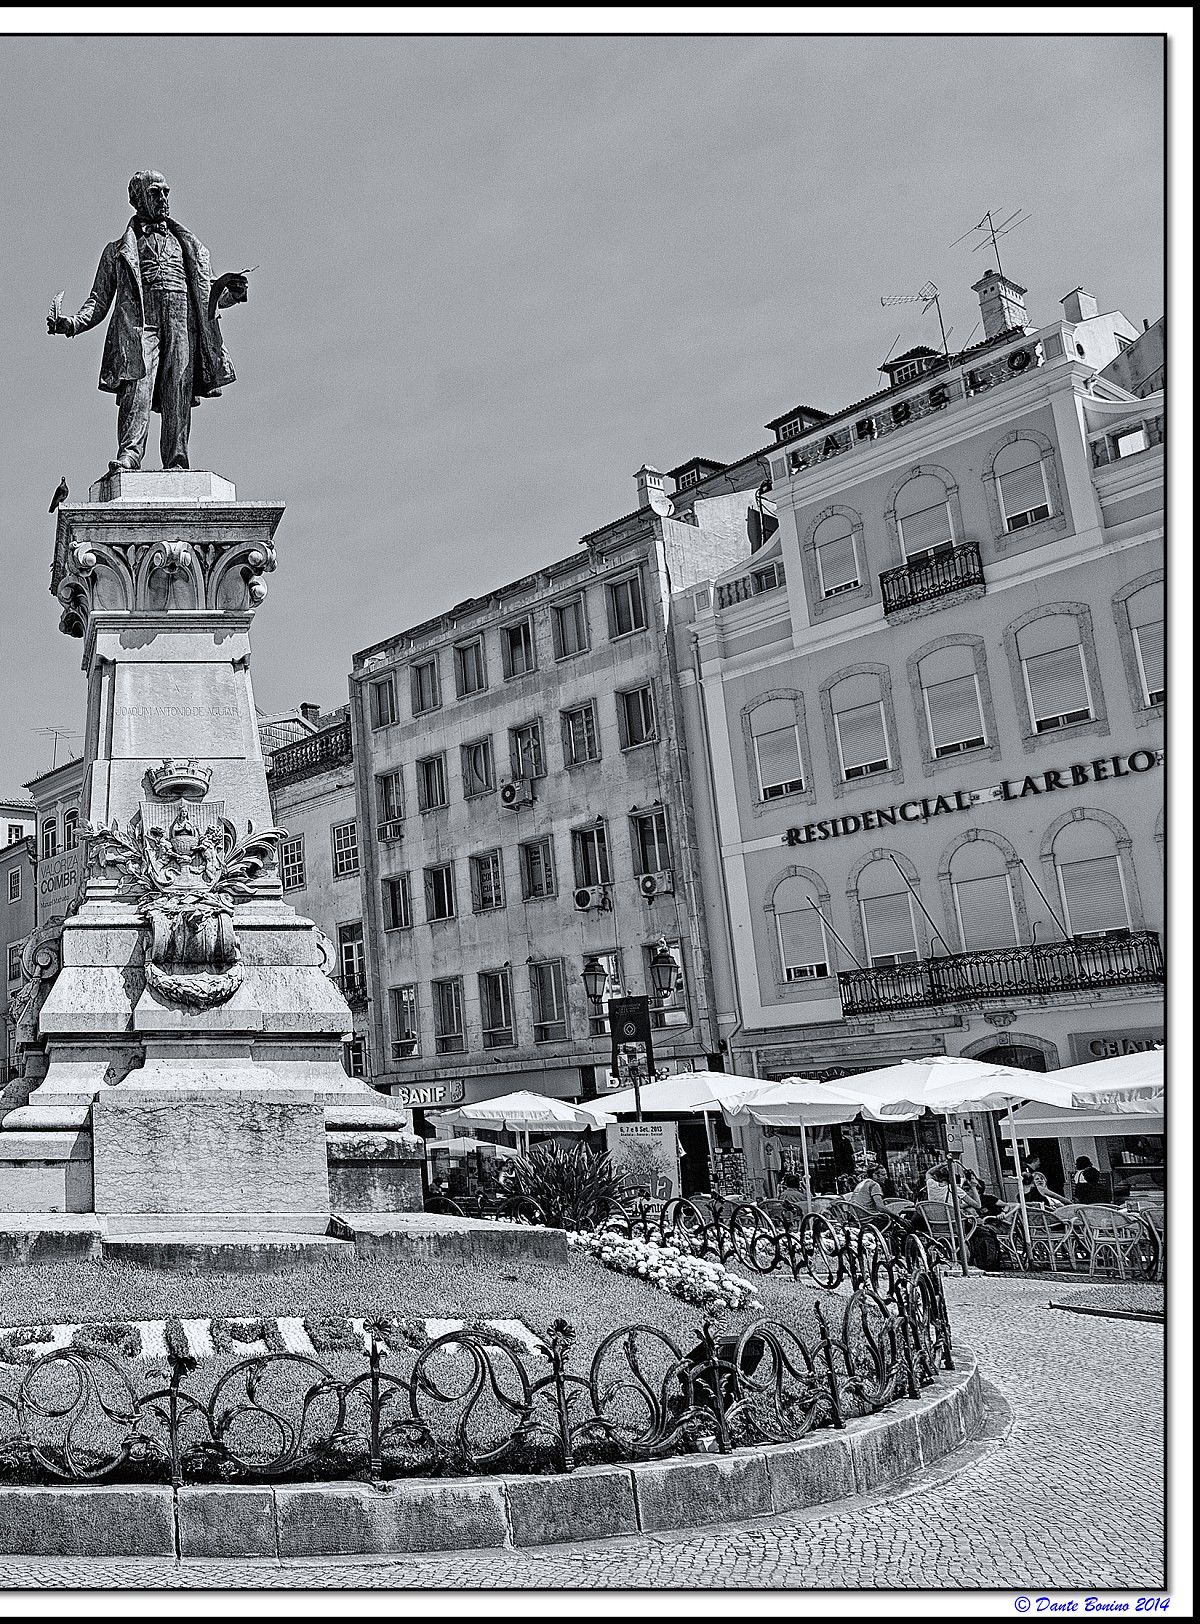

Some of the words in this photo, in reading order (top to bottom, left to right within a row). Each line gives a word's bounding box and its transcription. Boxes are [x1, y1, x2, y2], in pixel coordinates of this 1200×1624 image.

[790, 350, 1031, 469] LARBELO
[115, 706, 152, 717] JOAQUIM
[193, 706, 205, 717] DE
[207, 706, 240, 717] AGUIAR
[785, 790, 971, 847] RESIDENCIAL
[999, 750, 1156, 802] LARBELO
[40, 870, 78, 895] COIMBR
[398, 1085, 447, 1106] BANIF
